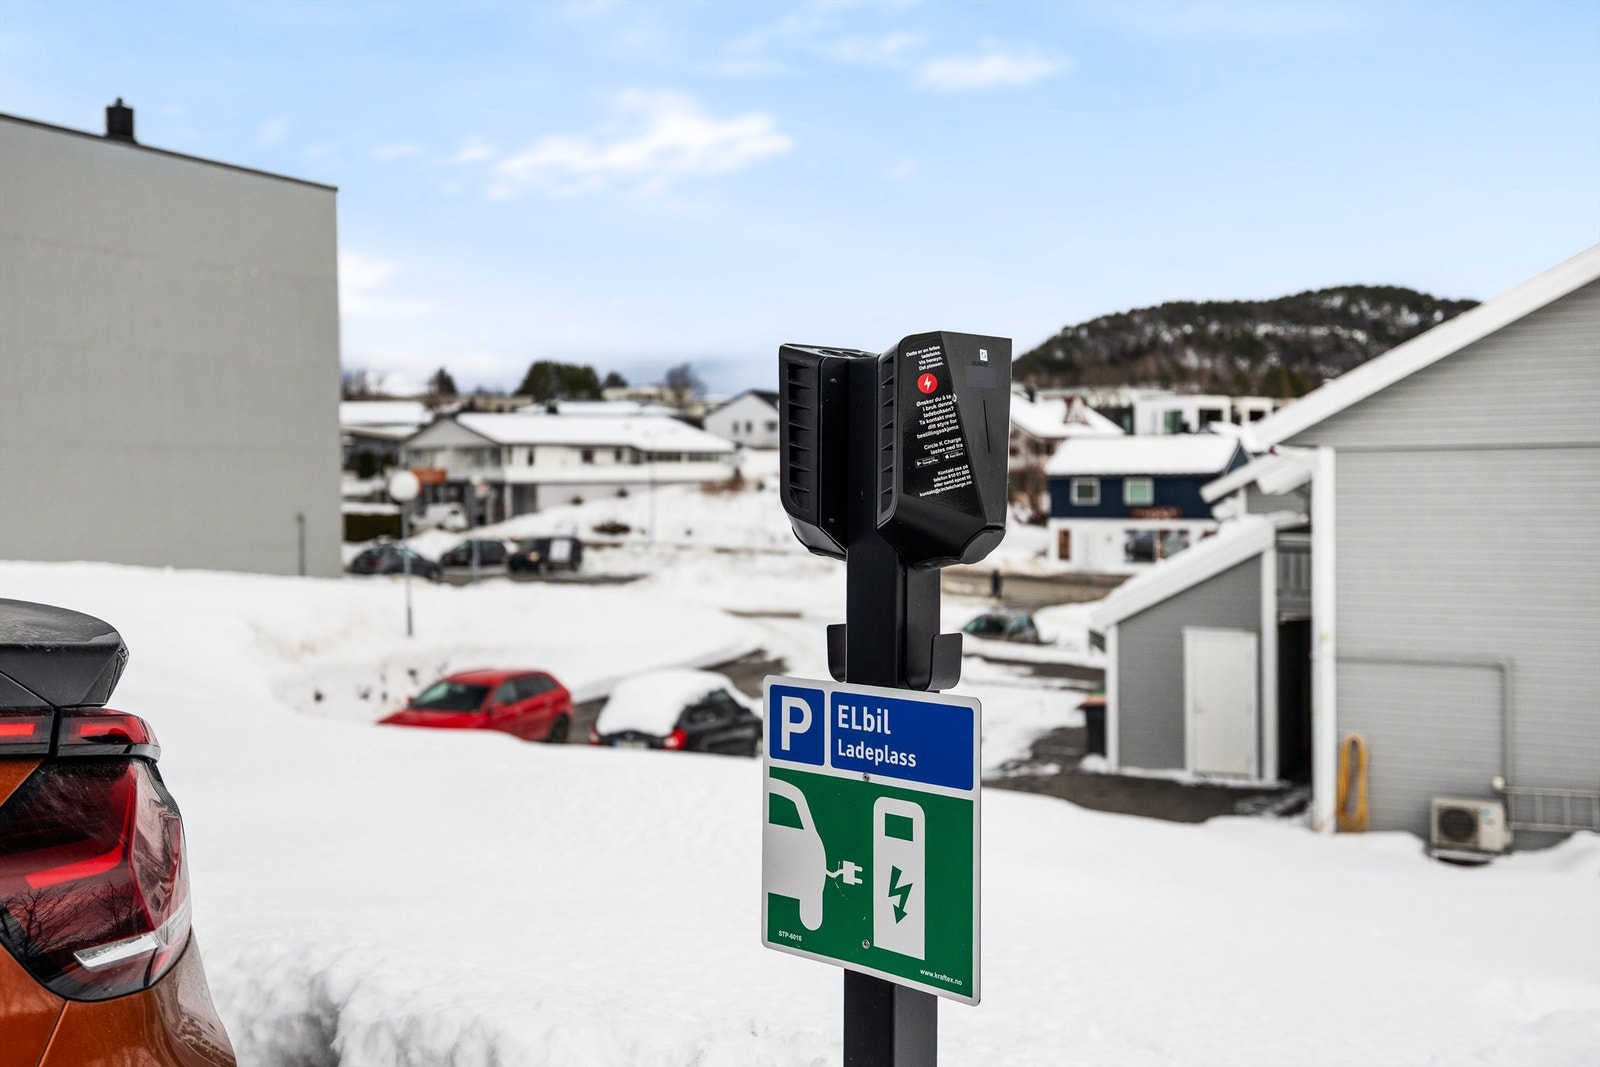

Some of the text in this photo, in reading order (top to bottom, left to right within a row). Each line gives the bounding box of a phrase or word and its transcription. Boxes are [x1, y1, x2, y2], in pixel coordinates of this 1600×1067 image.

[924, 406, 954, 417] ladeboksen?
[781, 696, 812, 751] P
[838, 704, 891, 734] ELbil
[838, 739, 916, 768] Ladeplass
[919, 968, 963, 986] www.kraftex.no
